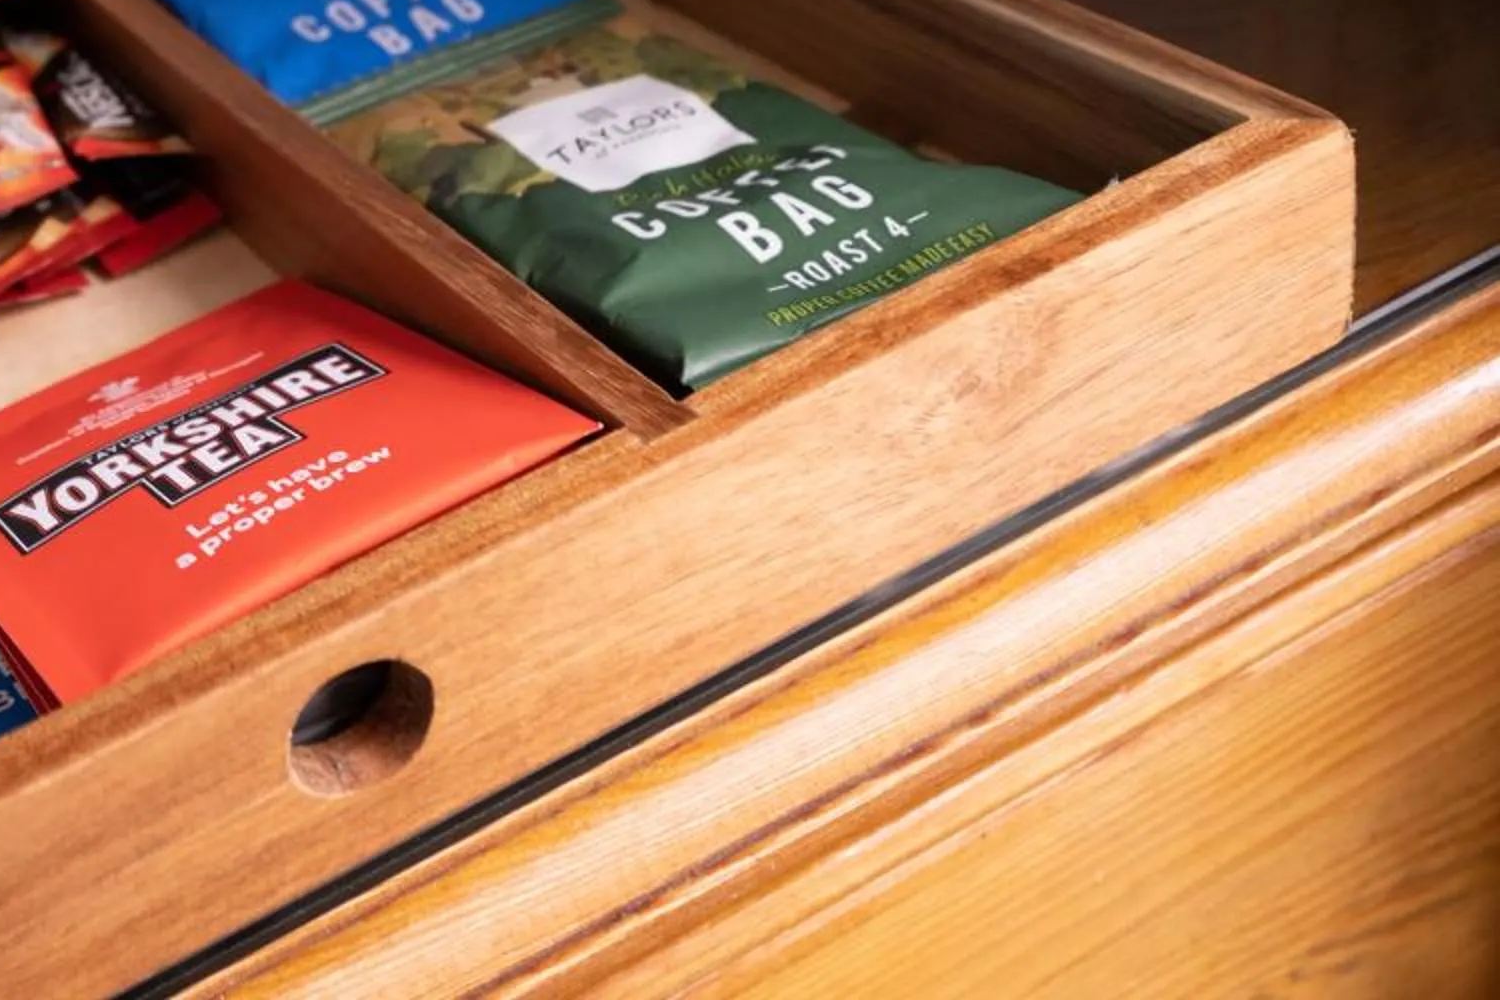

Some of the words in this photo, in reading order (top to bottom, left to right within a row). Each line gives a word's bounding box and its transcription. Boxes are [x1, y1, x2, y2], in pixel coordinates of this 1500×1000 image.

[546, 100, 697, 165] TAYLORS
[715, 175, 874, 264] BAG
[766, 292, 840, 328] PROPER
[899, 244, 952, 281] MADE
[949, 221, 996, 255] EASY
[8, 354, 368, 535] YORKSHIRE
[149, 422, 288, 494] TEA
[174, 550, 198, 570] a
[198, 488, 309, 559] proper
[307, 445, 393, 491] brew
[185, 488, 268, 540] Let's
[267, 448, 352, 492] have
